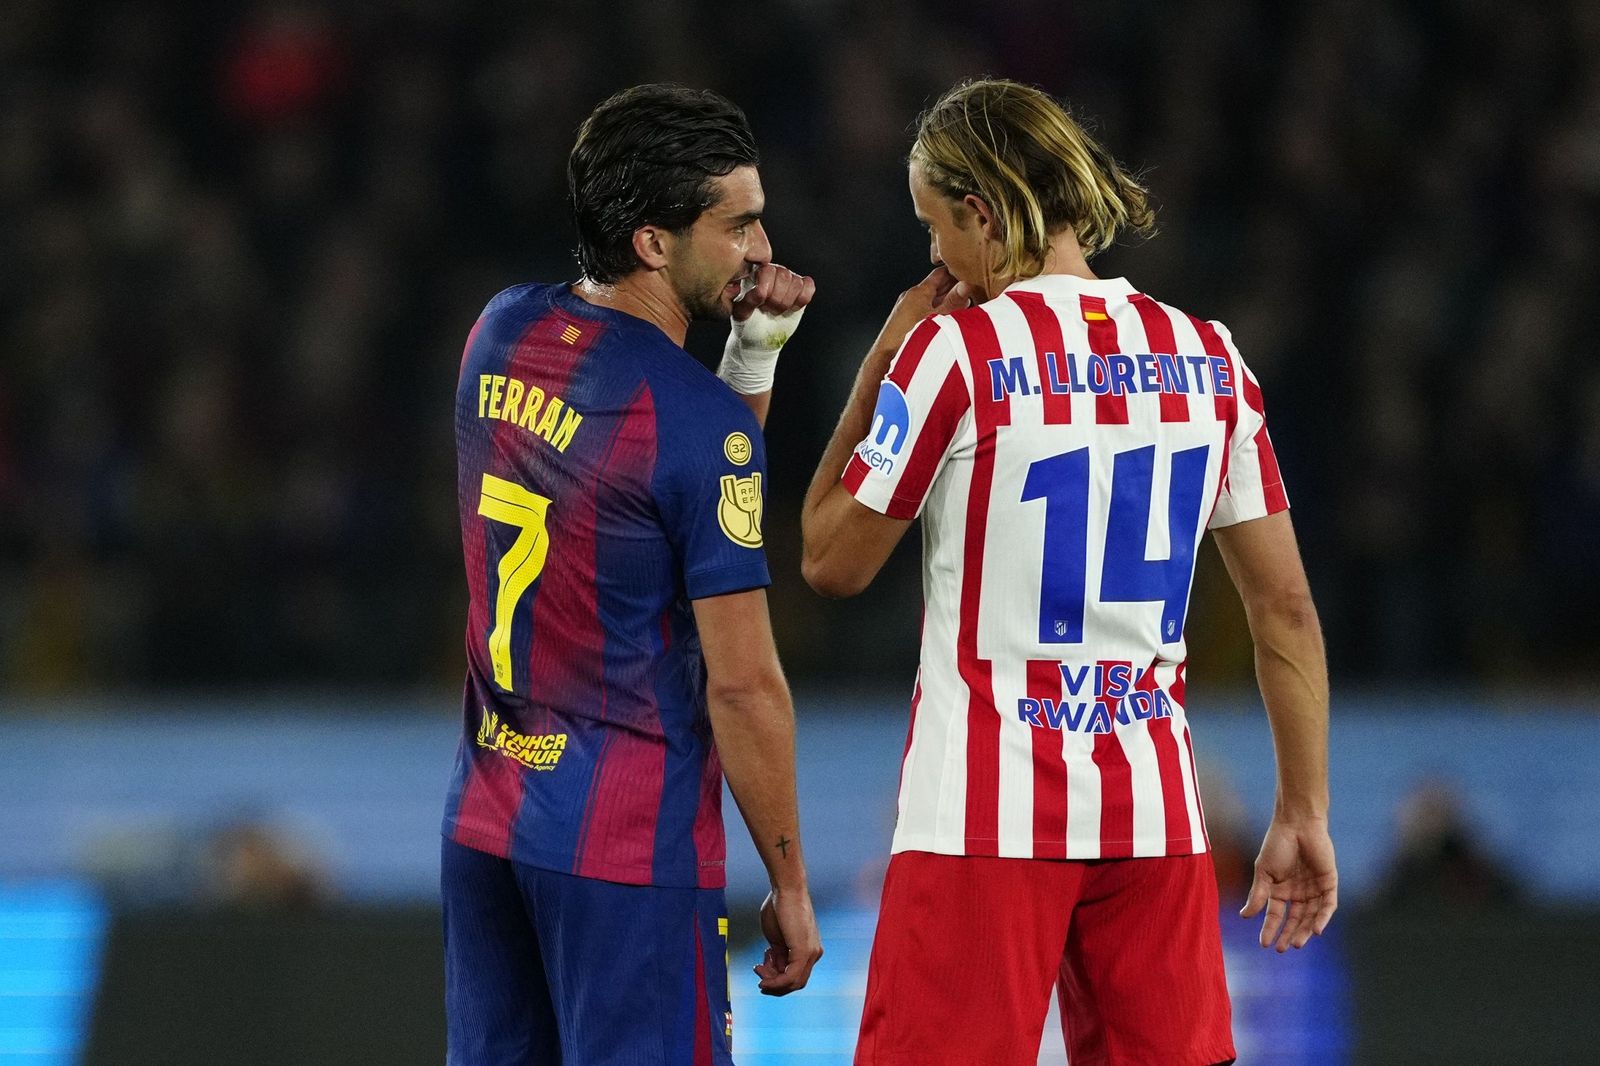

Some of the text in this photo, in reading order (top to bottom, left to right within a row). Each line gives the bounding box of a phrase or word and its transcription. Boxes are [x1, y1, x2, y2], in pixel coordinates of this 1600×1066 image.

[987, 352, 1234, 401] M. LLORENTE
[478, 374, 583, 453] FERRAN
[732, 443, 746, 454] 32
[1020, 444, 1210, 644] 14
[477, 473, 553, 692] 7
[1017, 688, 1173, 733] RWANDA
